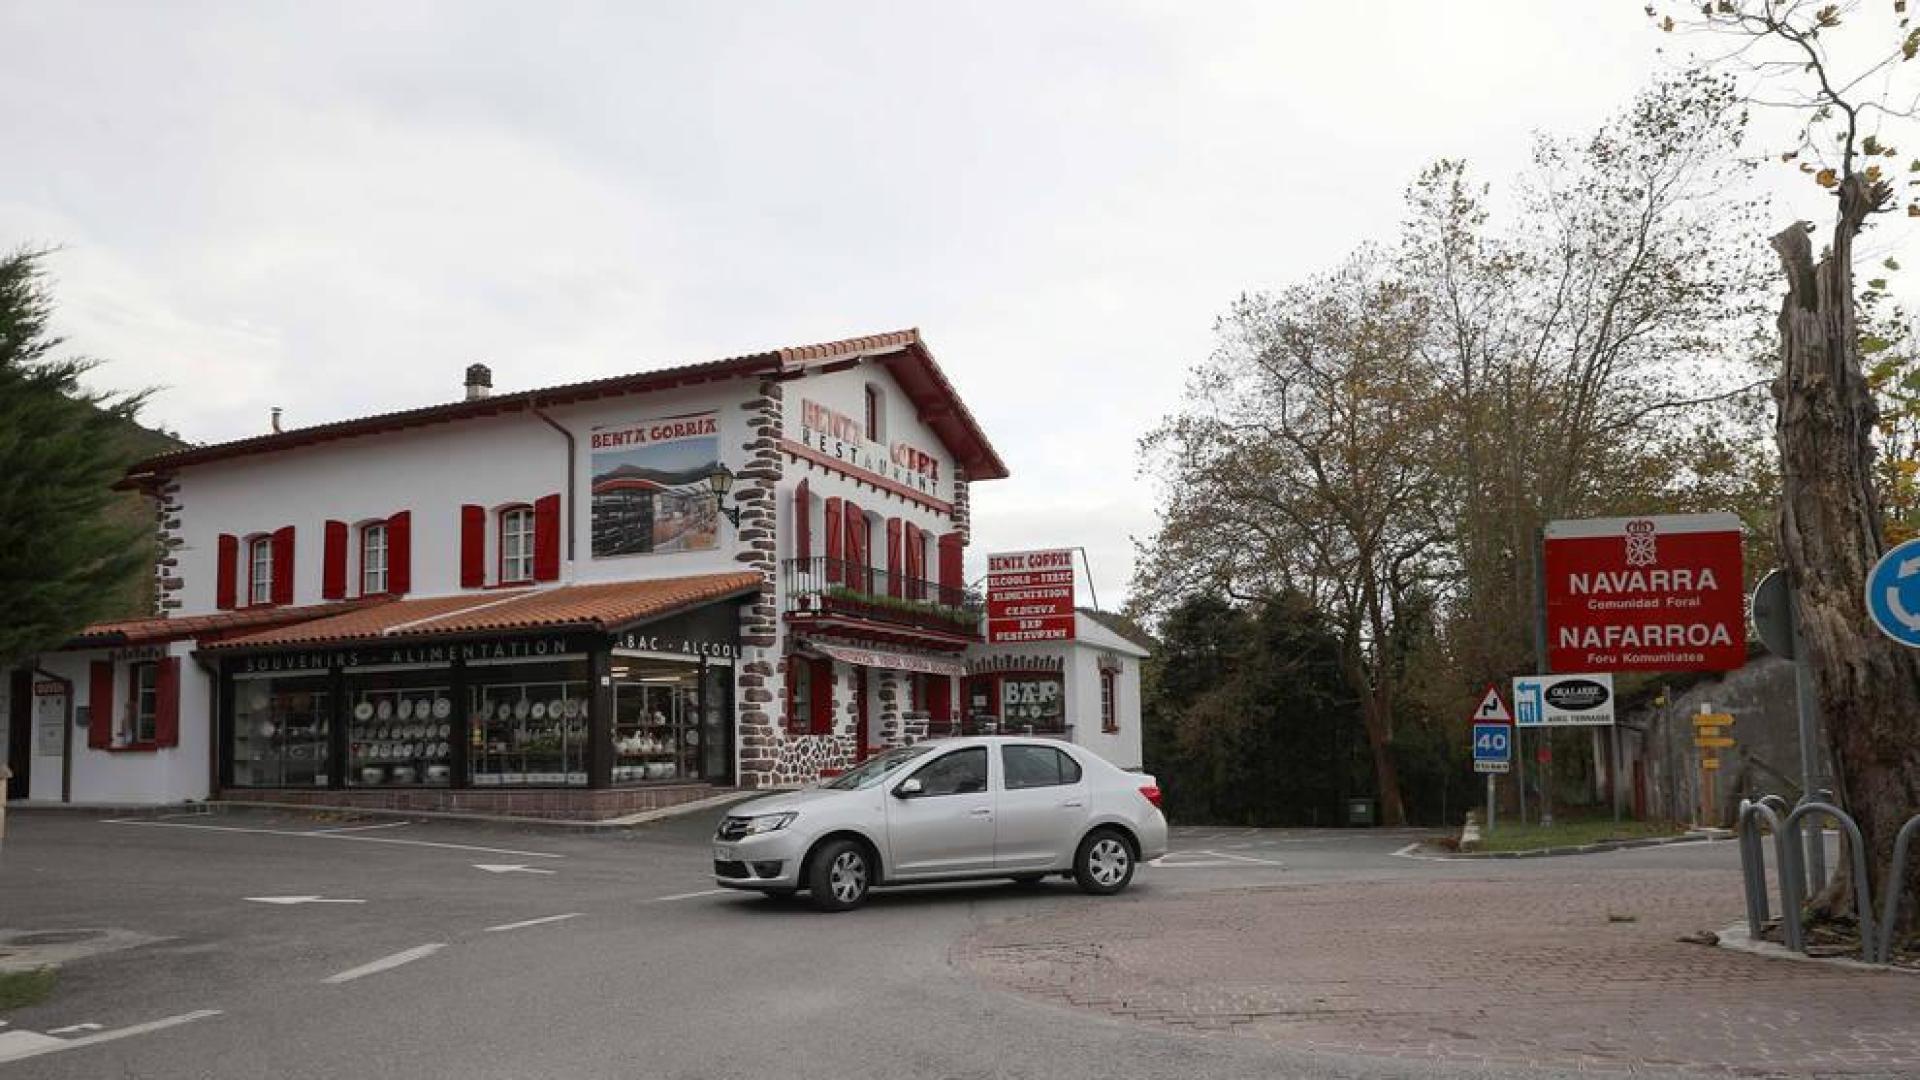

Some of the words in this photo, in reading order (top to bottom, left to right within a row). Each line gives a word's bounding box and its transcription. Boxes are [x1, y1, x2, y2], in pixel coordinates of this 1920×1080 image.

[592, 428, 646, 449] BENTA
[651, 418, 717, 441] GORRIA
[1569, 568, 1718, 595] NAVARRA
[1588, 598, 1659, 610] Comunidad
[1666, 596, 1701, 607] Foral
[1559, 623, 1733, 649] NAFARROA
[247, 652, 358, 672] SOUVENIRS
[392, 639, 566, 662] ALIMENTATION
[1588, 653, 1616, 664] Foru
[1622, 651, 1704, 663] Komunitatea
[1005, 681, 1057, 703] BAR
[1477, 734, 1506, 751] 40
